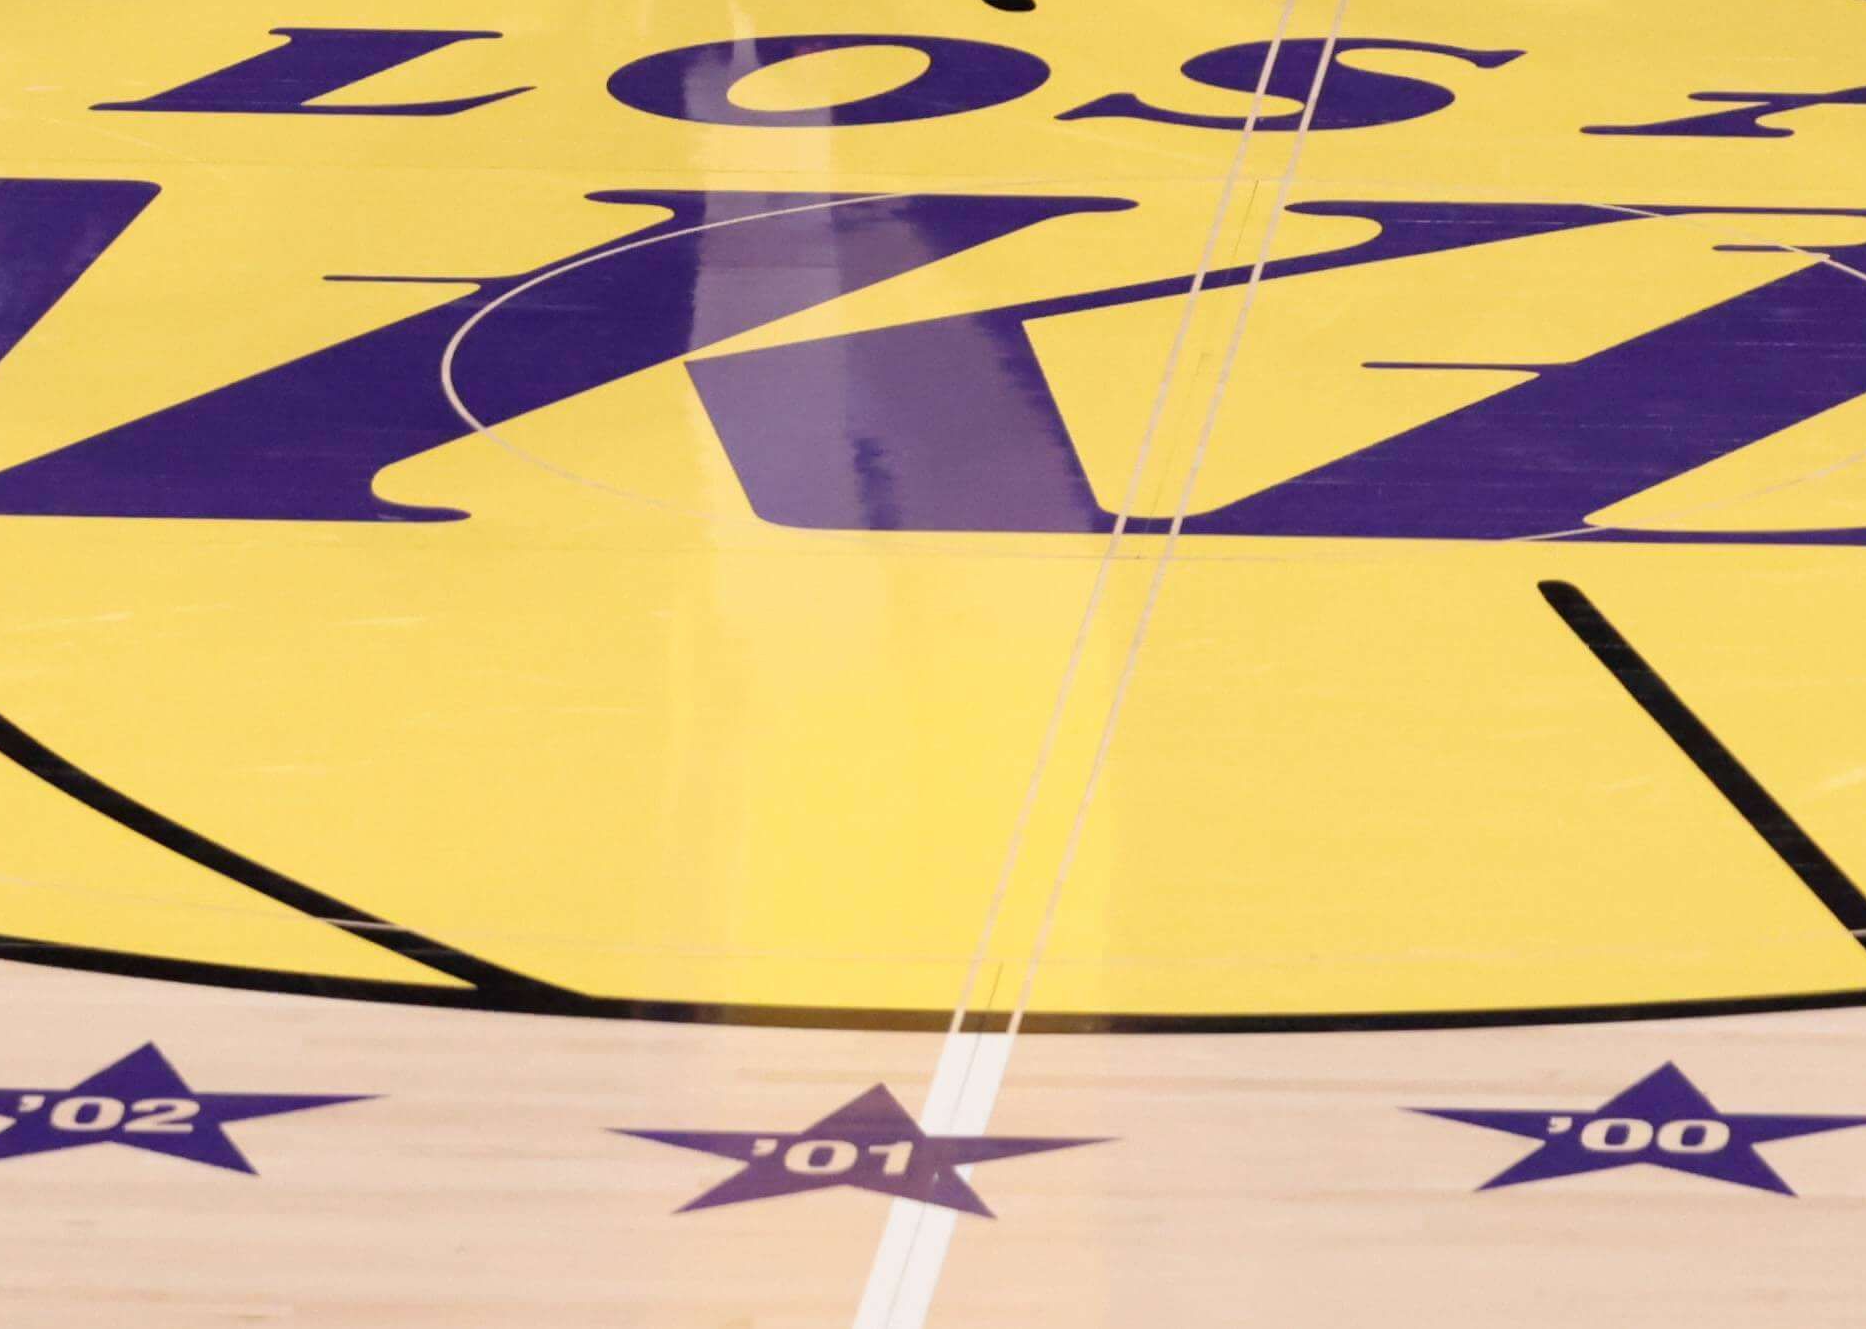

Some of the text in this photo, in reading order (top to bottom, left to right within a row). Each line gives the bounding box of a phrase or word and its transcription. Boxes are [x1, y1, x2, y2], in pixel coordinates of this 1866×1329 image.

[91, 28, 1526, 132] LOS
[14, 1094, 202, 1134] '02
[1548, 1114, 1732, 1156] '00
[752, 1138, 914, 1176] '01
